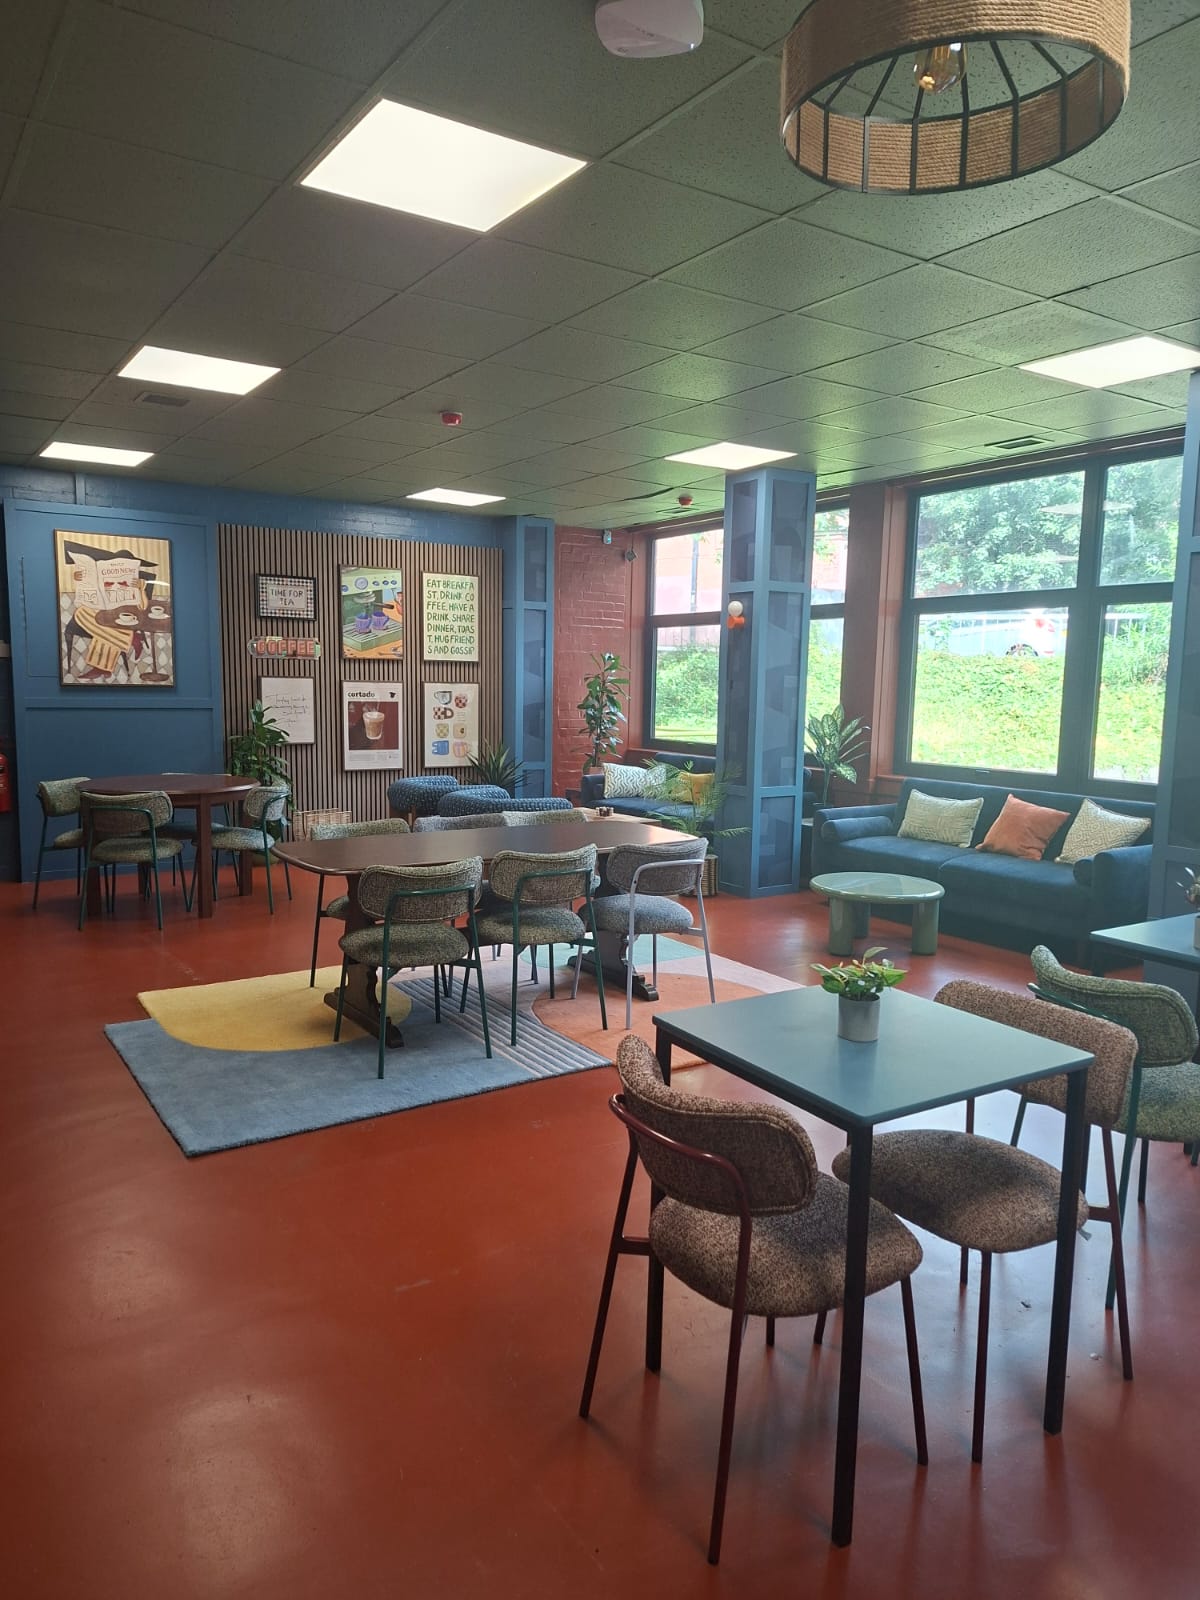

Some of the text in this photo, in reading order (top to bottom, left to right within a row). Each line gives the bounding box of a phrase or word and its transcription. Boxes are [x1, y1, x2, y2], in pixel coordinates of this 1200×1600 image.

[427, 579, 474, 590] EAT BREAKFA
[271, 588, 303, 598] TIME FOR
[427, 590, 474, 601] ST, DRINK CO
[280, 598, 295, 606] TEA
[427, 602, 448, 611] FFEE,
[449, 603, 467, 611] HAVE
[427, 612, 474, 622] DRINK, SHARE
[427, 623, 474, 633] DINNER, TOAS
[434, 635, 449, 643] HUG
[450, 635, 474, 644] FRIEND
[257, 640, 314, 656] COFFEE
[427, 645, 474, 655] S AND GOSSIP
